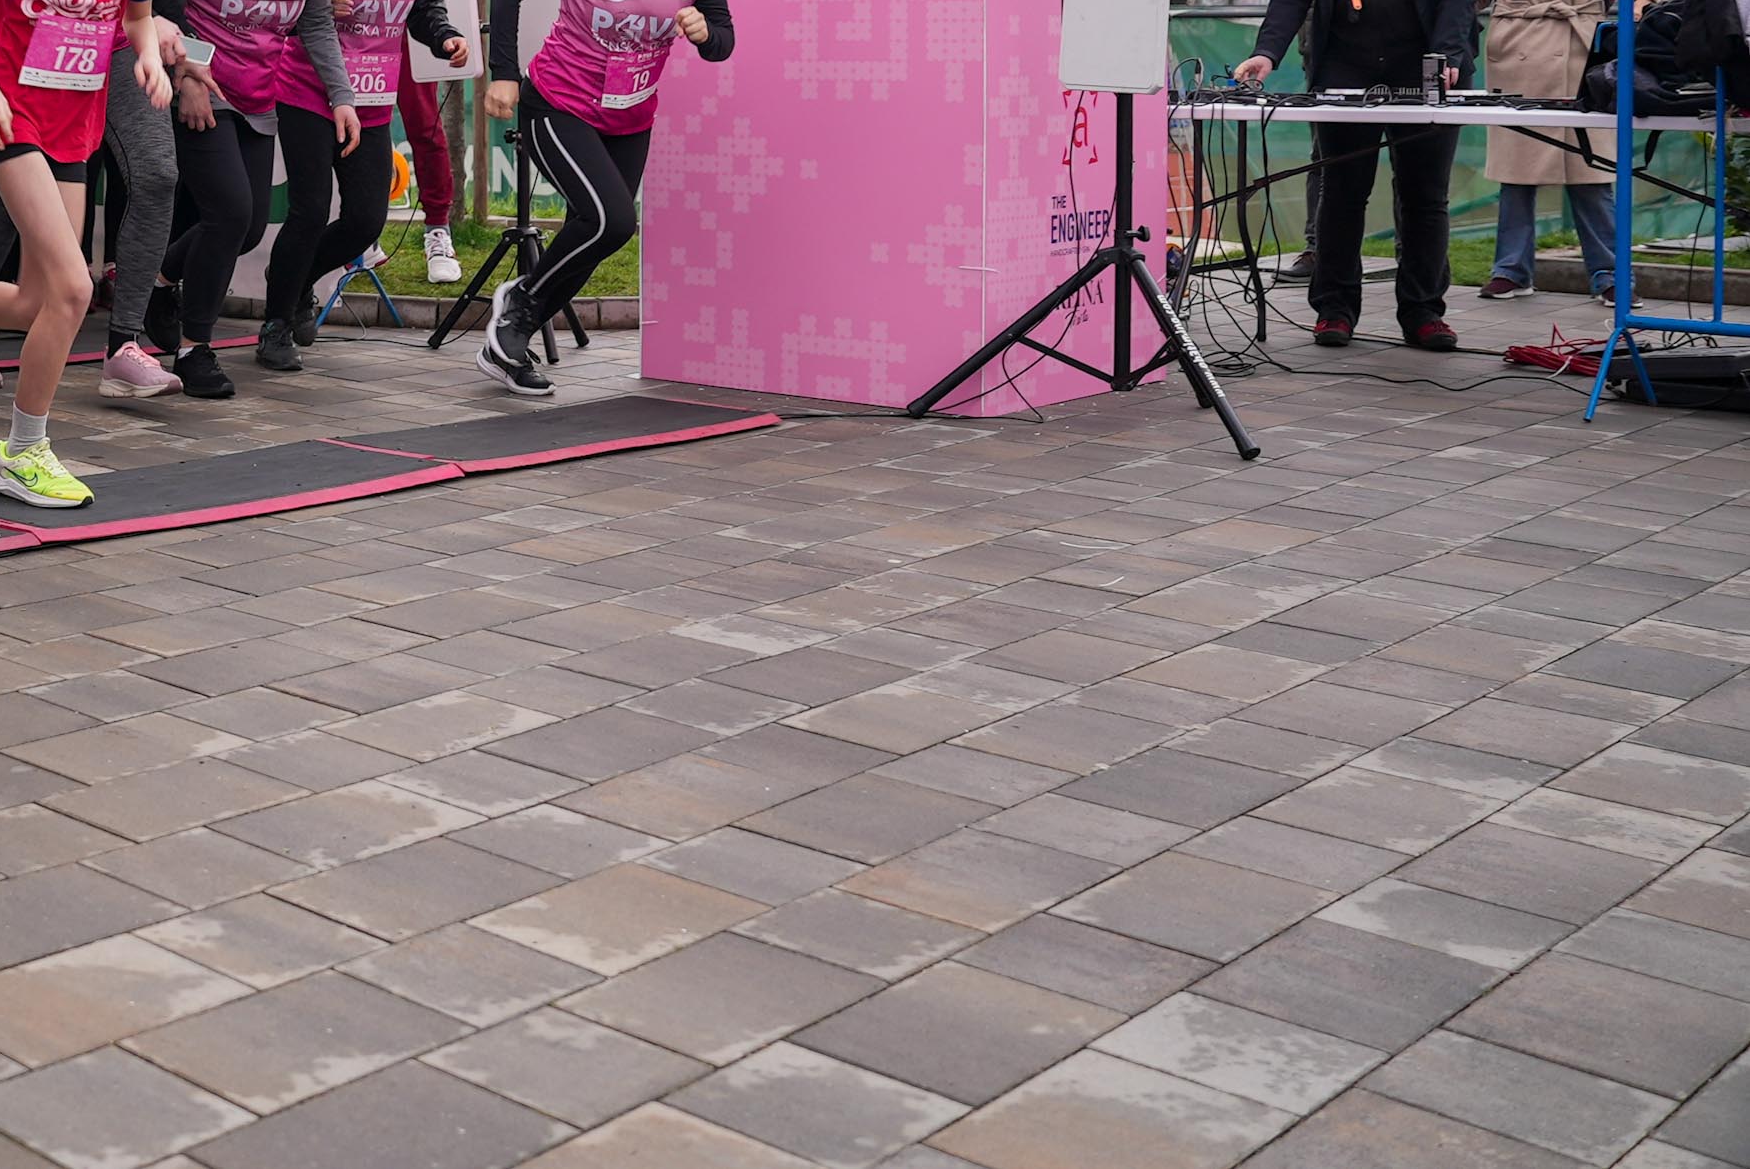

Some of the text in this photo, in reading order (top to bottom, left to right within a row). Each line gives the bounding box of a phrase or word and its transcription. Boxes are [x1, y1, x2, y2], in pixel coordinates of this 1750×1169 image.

[335, 23, 380, 37] ENSKA
[54, 45, 98, 73] 178
[350, 73, 387, 93] 206
[633, 70, 650, 93] 19
[1052, 195, 1067, 209] THE
[1051, 209, 1110, 244] ENGINEER
